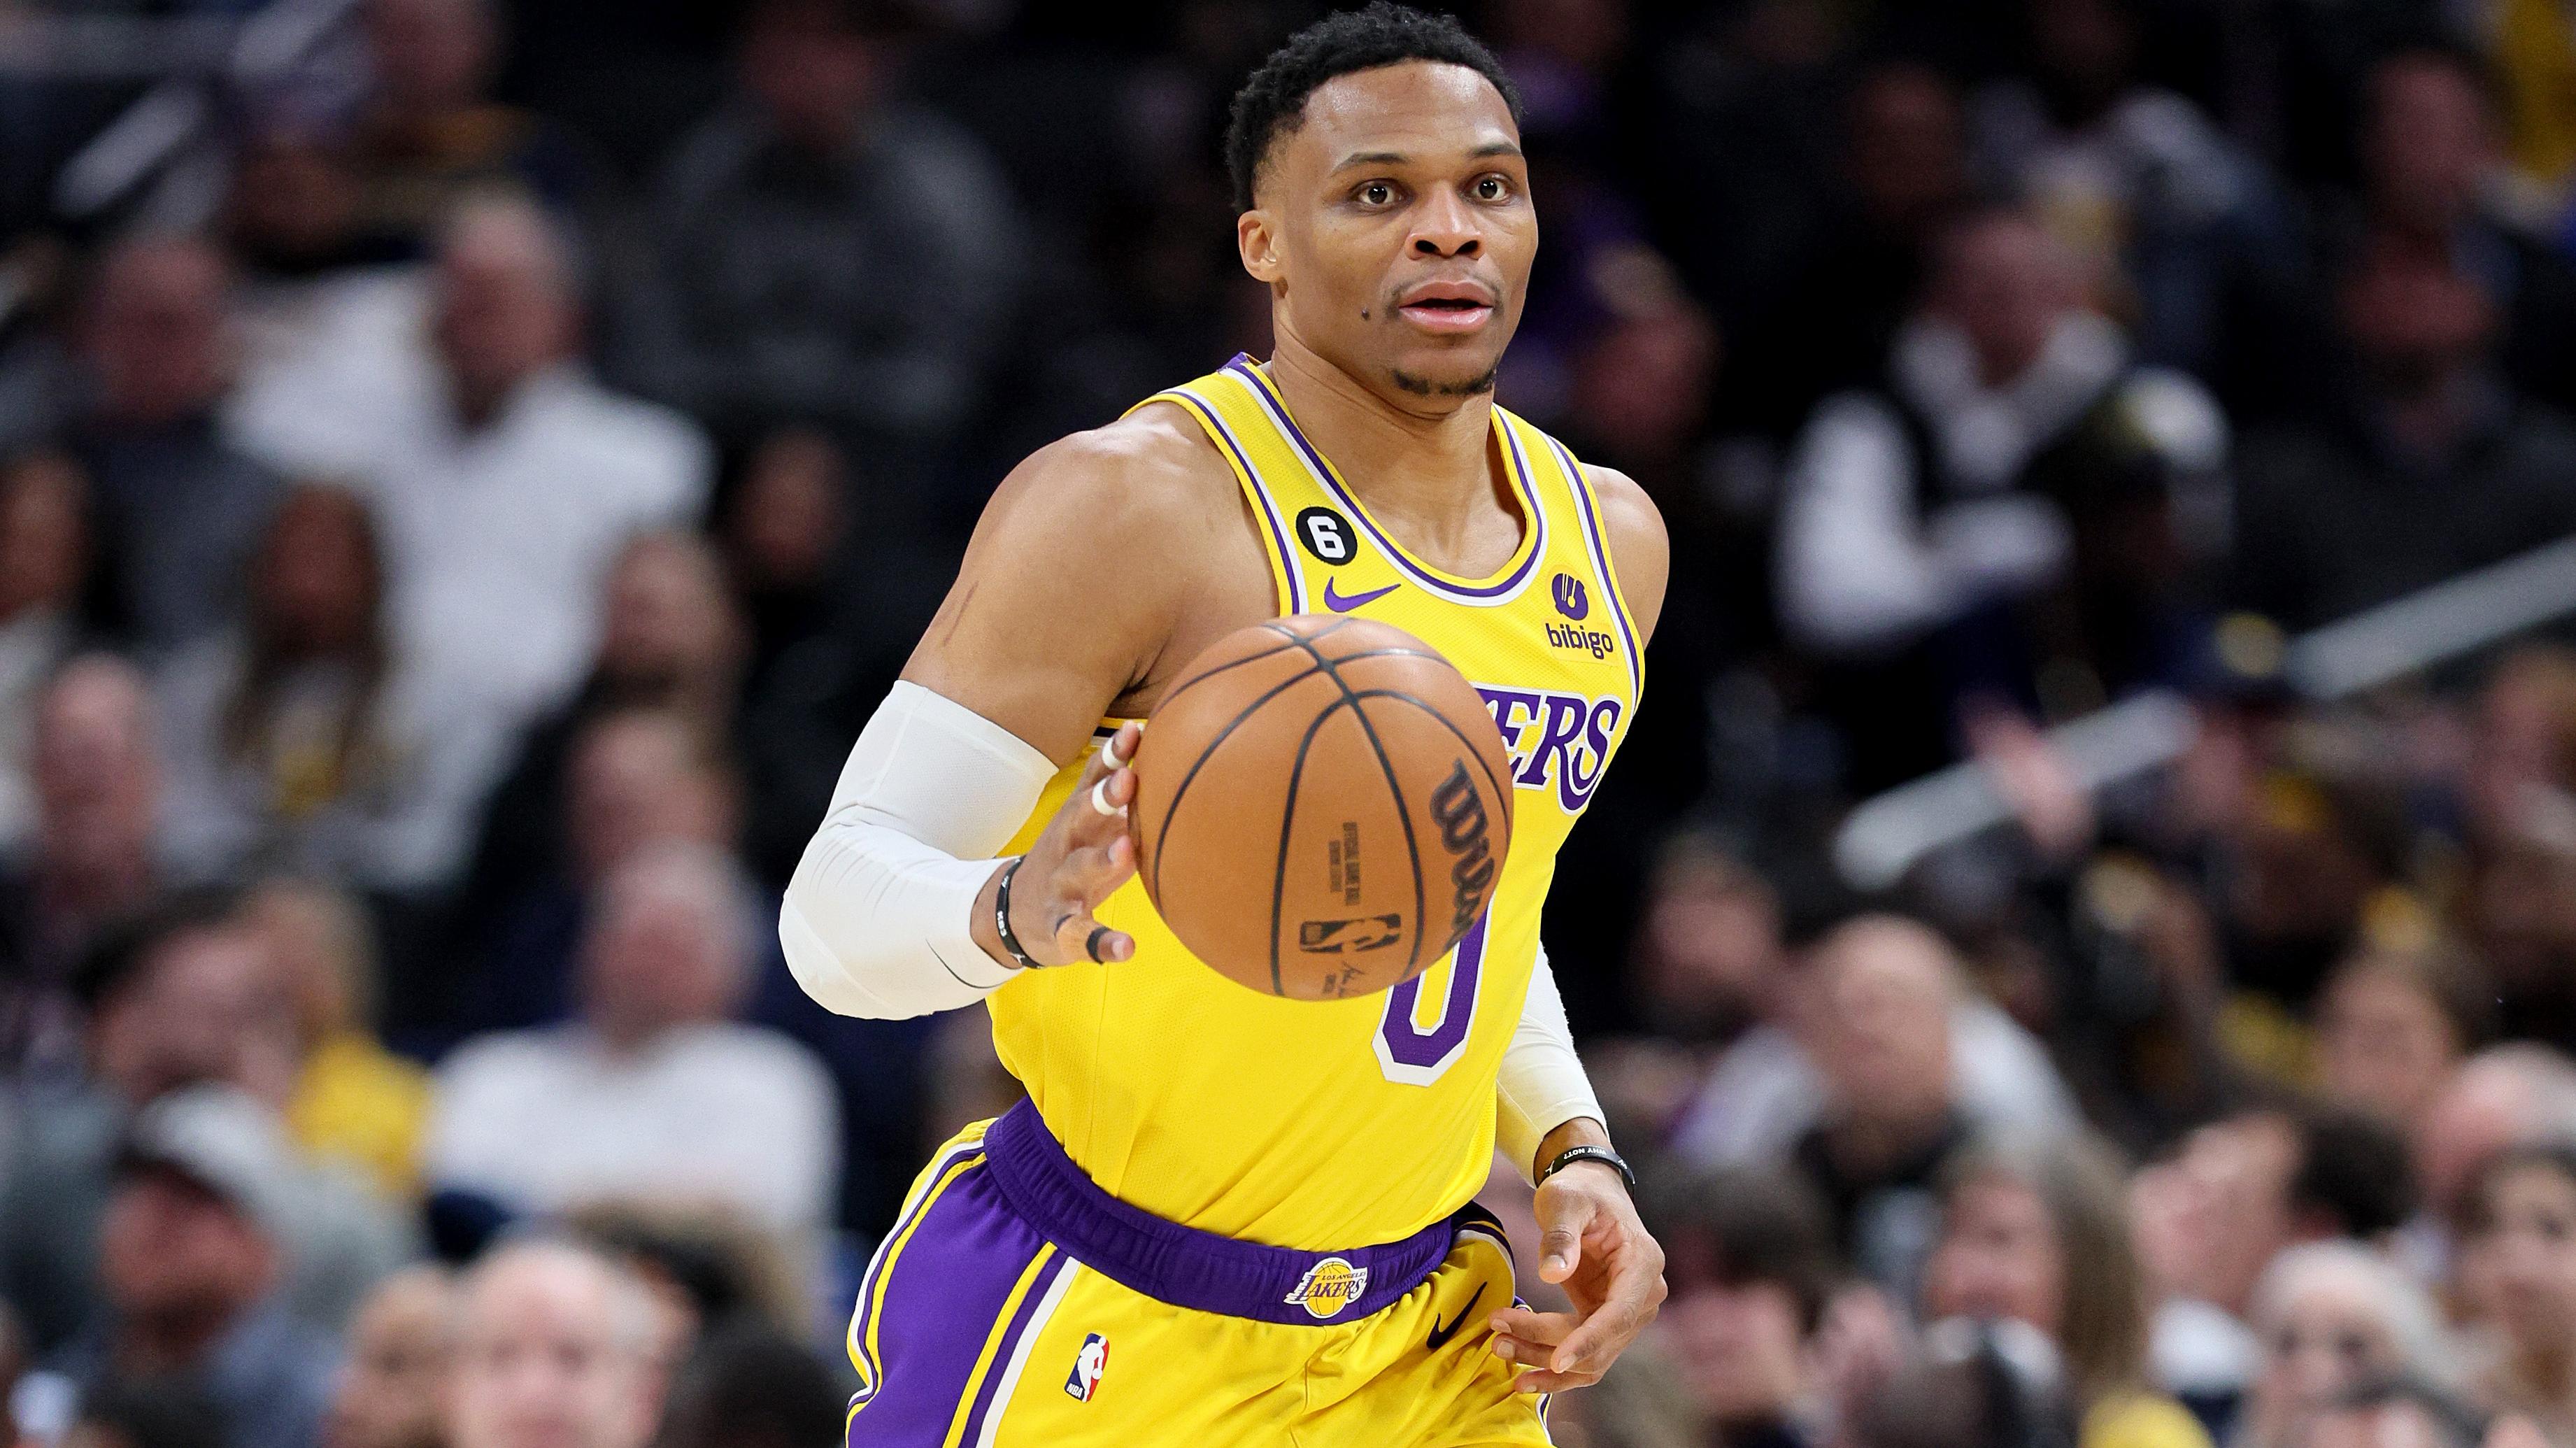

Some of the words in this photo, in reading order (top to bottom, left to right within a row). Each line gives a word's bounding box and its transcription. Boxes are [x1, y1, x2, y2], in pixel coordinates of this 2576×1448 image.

[1307, 516, 1346, 559] 6
[1545, 623, 1614, 660] bibigo
[1470, 682, 1624, 816] ERS
[1564, 1148, 1585, 1160] NOT?
[1587, 1147, 1607, 1156] WHY
[1288, 1273, 1366, 1302] LAKERS
[1067, 1383, 1083, 1398] NBA
